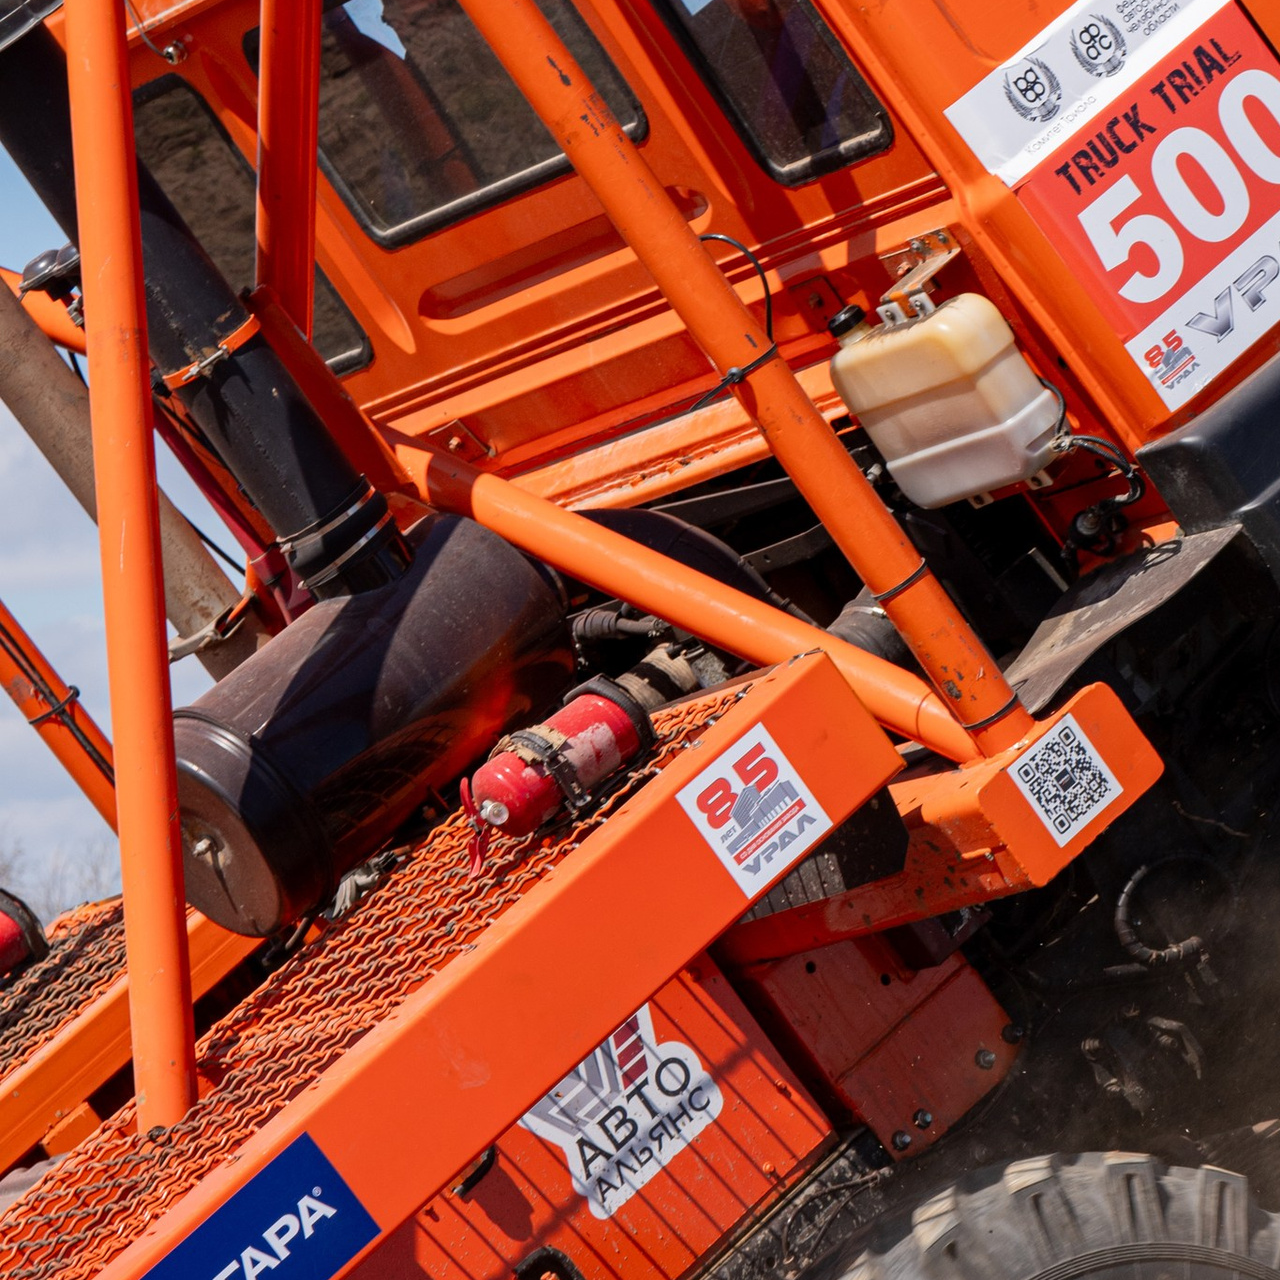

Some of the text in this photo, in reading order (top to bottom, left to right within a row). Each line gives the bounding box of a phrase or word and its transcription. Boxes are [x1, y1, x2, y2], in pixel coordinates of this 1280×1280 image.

[1055, 37, 1242, 196] TRUCK TRIAL
[1144, 329, 1183, 369] 85
[1165, 362, 1200, 390] УРАЛ
[696, 741, 779, 830] 85
[720, 824, 738, 843] лет
[741, 813, 817, 876] УРАЛ
[575, 1056, 691, 1181] АВТО
[595, 1085, 711, 1204] АЛЬЯНС
